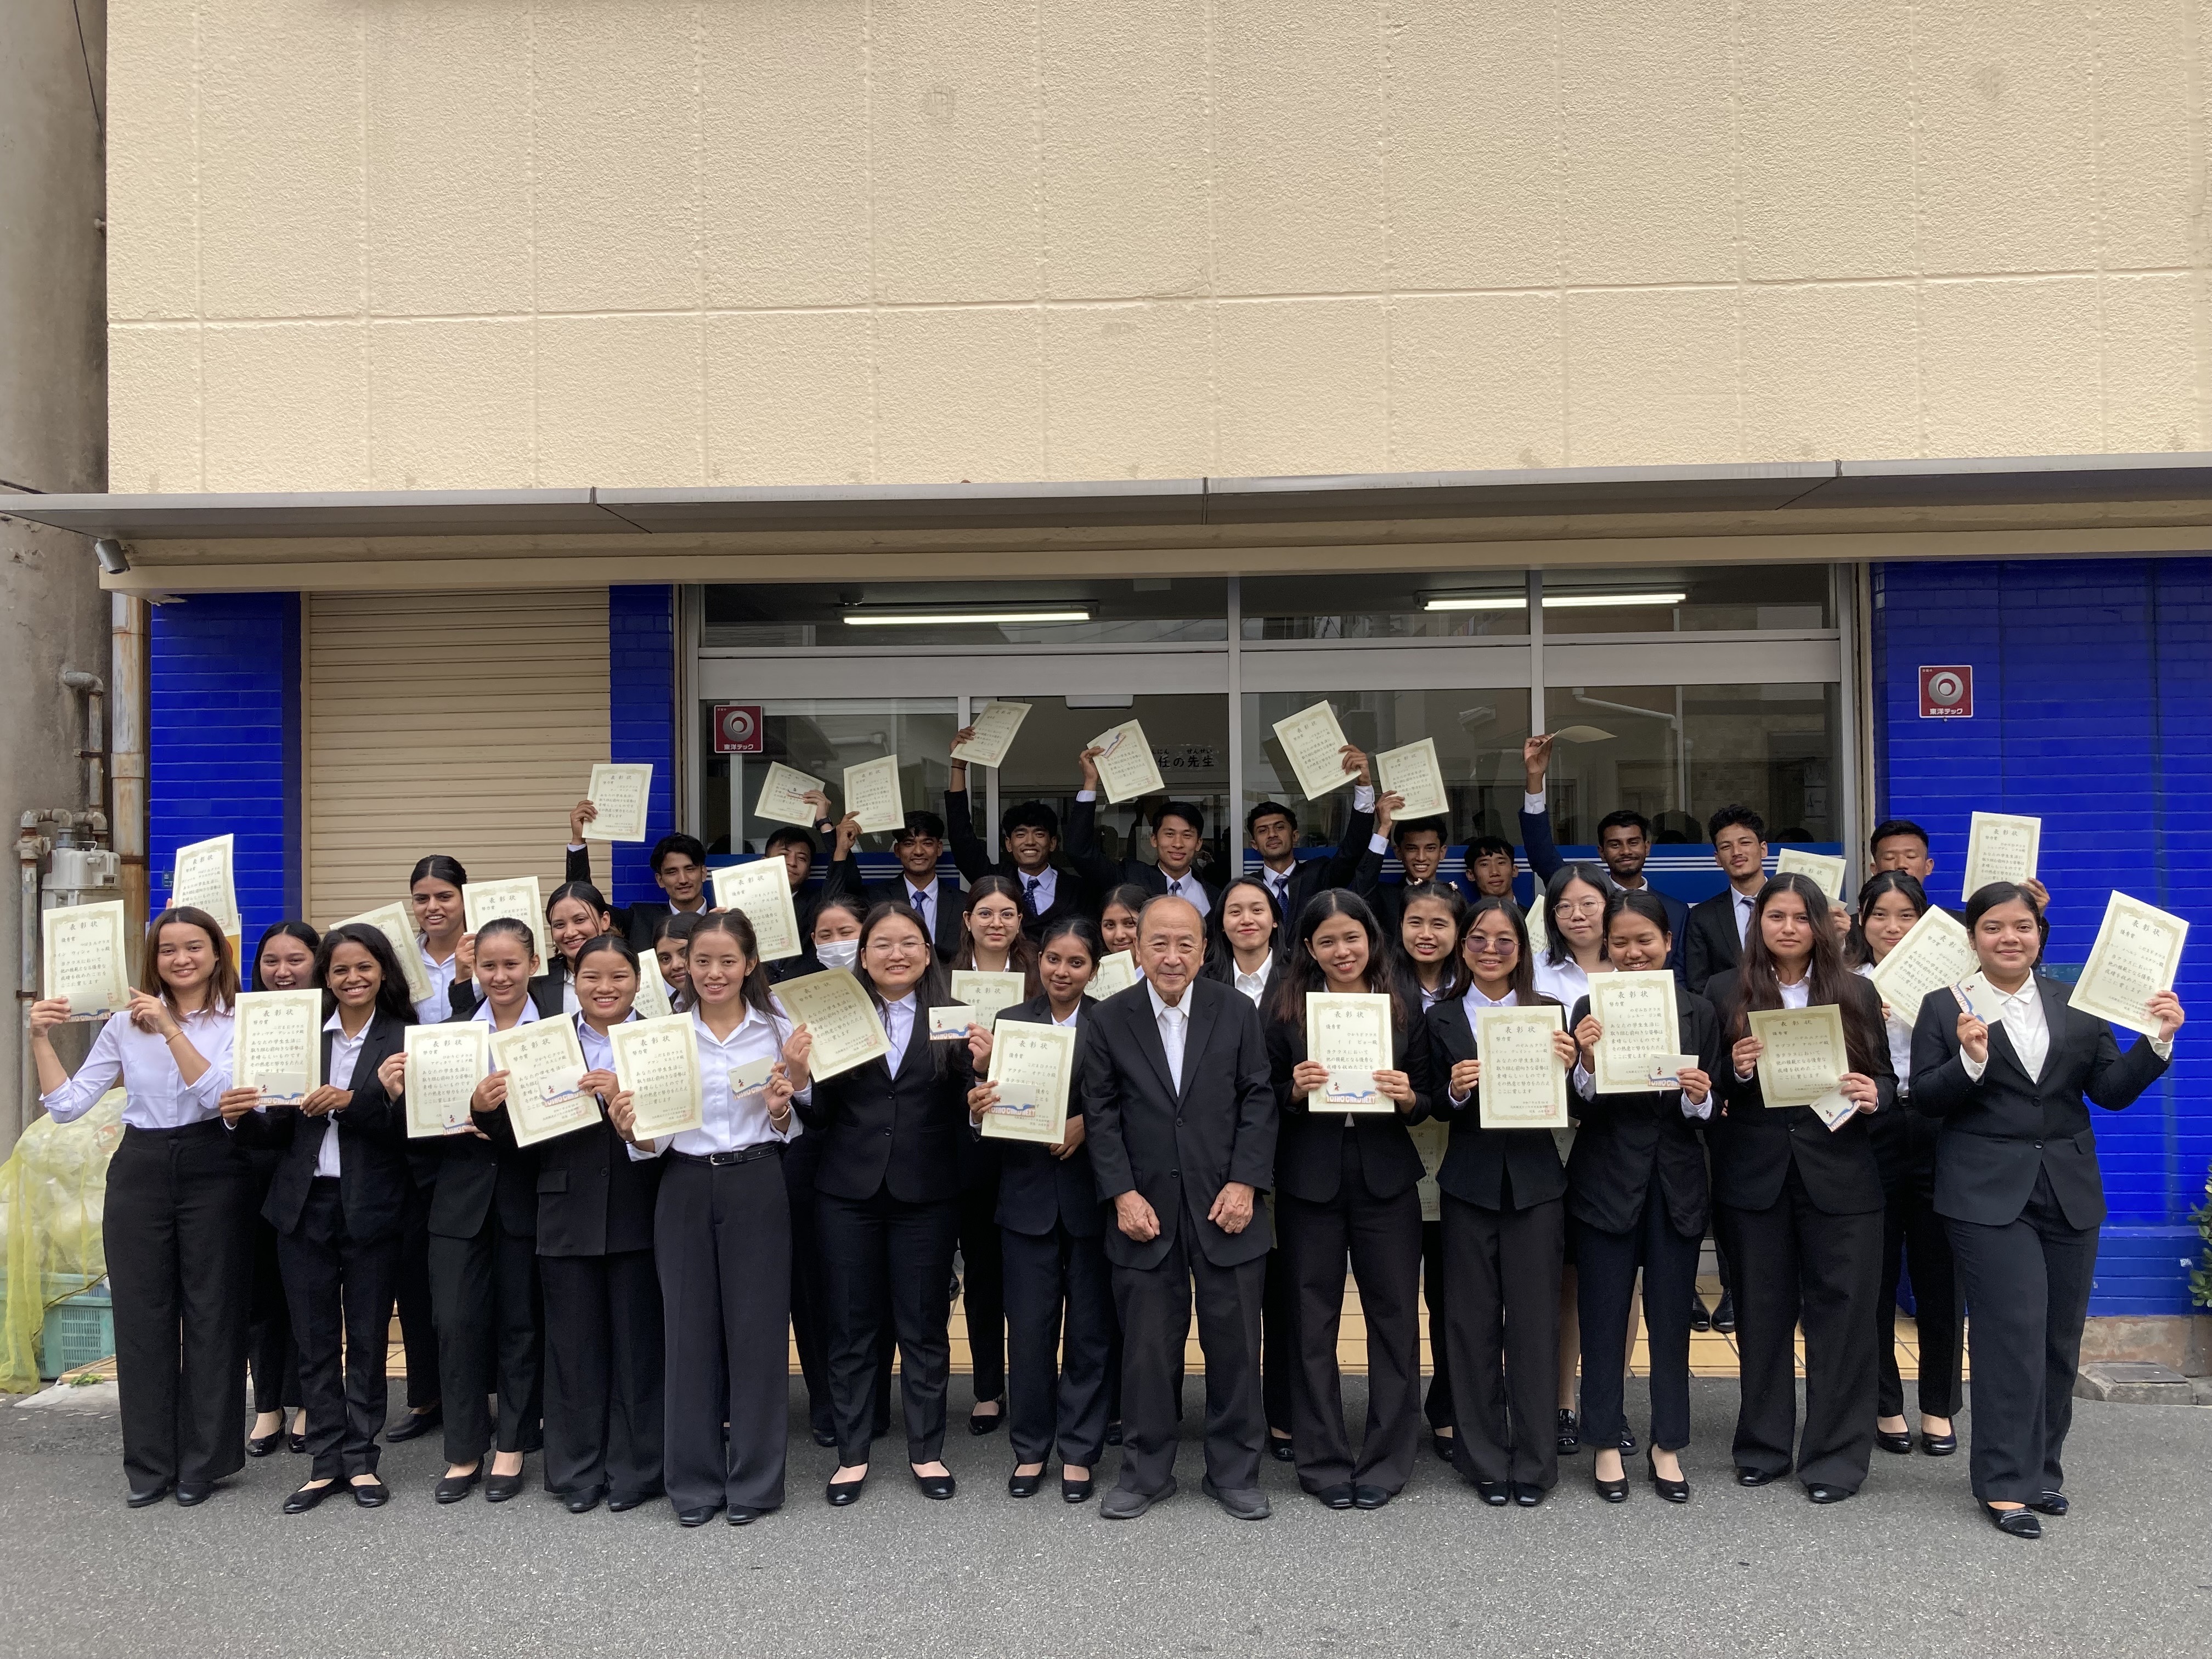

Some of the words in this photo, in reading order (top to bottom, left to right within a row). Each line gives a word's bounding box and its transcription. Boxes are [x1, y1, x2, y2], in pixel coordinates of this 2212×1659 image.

[1158, 755, 1214, 768] 任の先生
[738, 874, 764, 885] 表彰状
[489, 895, 516, 904] 表彰状
[2132, 919, 2161, 937] 表彰状
[1939, 933, 1966, 956] 表彰状
[803, 981, 832, 995] 表彰状
[1617, 990, 1649, 999] 表彰状
[263, 1008, 293, 1017] 表彰状
[432, 1039, 462, 1047] 表彰状
[519, 1037, 551, 1052] 表彰状
[640, 1034, 670, 1047] 表彰状
[1019, 1040, 1048, 1049] 表彰状
